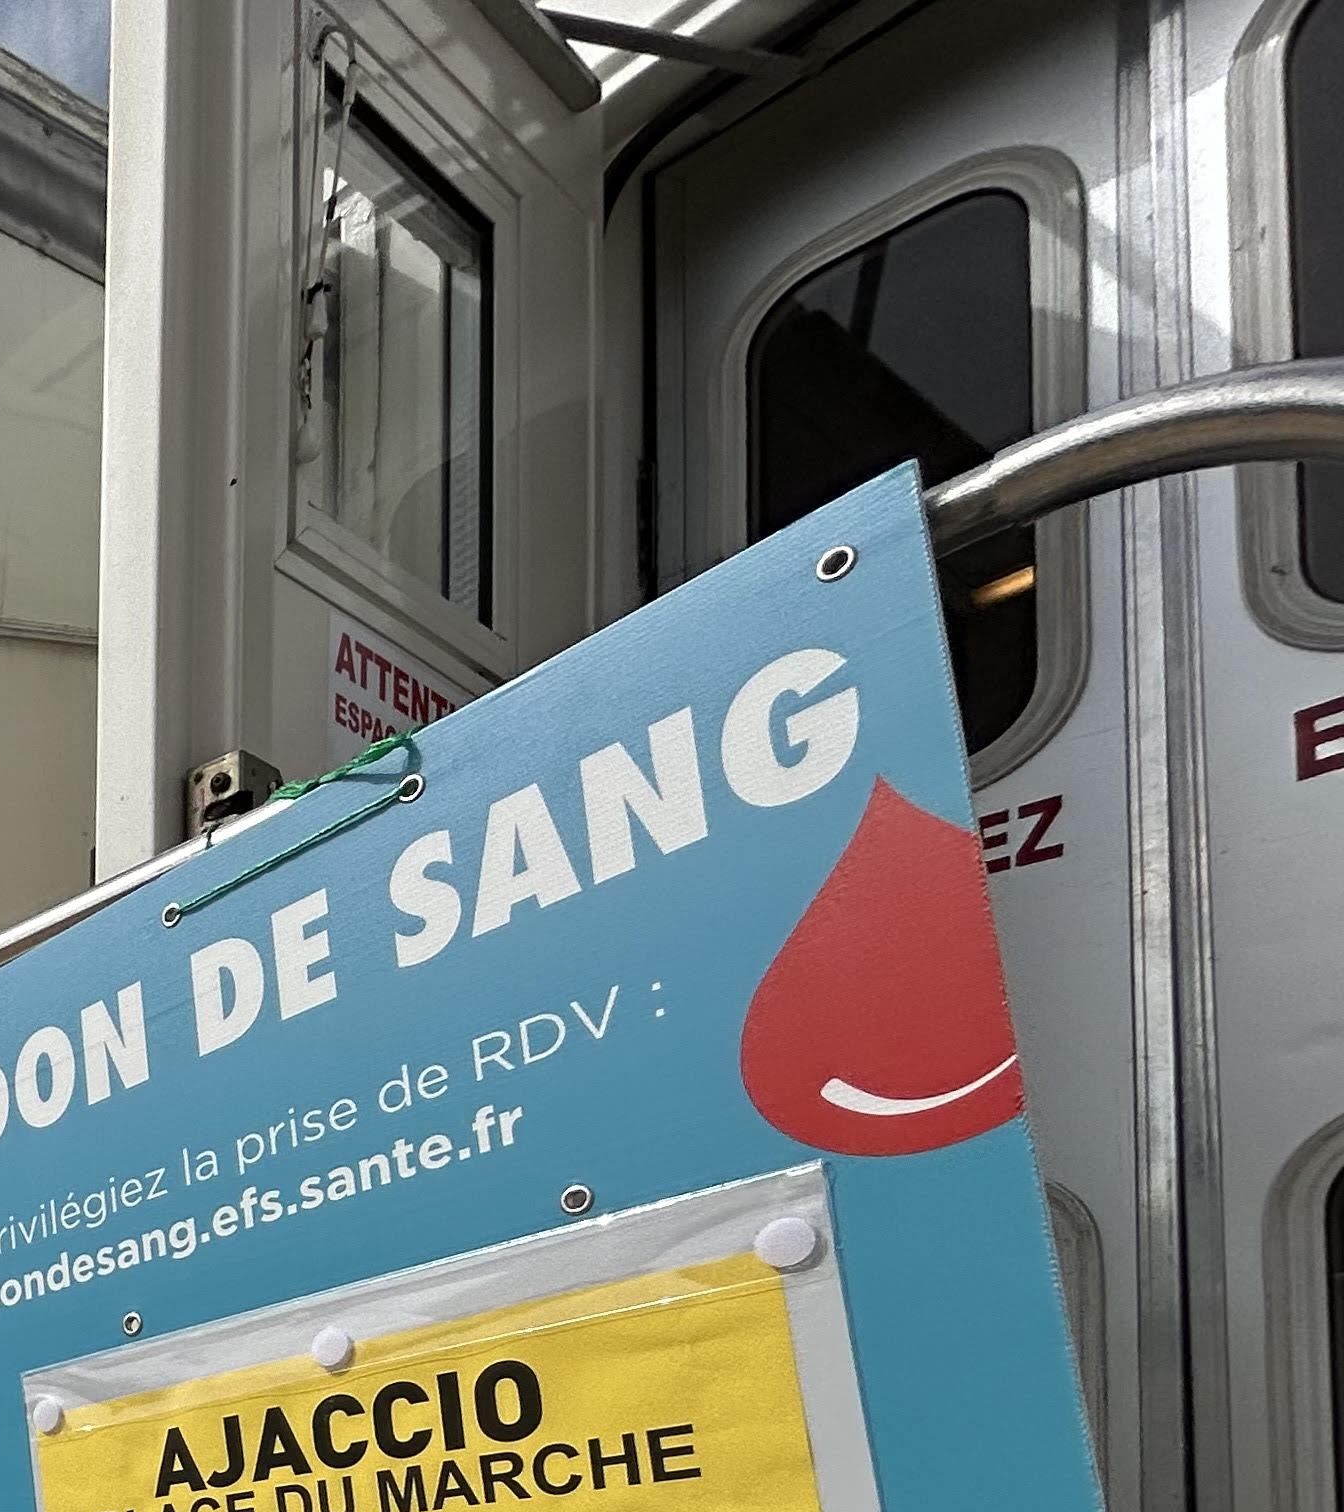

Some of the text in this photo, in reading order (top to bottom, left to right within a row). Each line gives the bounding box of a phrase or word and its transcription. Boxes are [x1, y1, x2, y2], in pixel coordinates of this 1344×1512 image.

[335, 632, 457, 724] ATTENT
[190, 888, 338, 1057] DE
[389, 648, 860, 969] SANG
[979, 795, 1064, 873] EZ
[183, 1147, 219, 1186] la
[237, 1097, 358, 1175] prise
[378, 1064, 449, 1112] de
[472, 986, 619, 1081] RDV
[154, 1360, 543, 1498] AJACCIO
